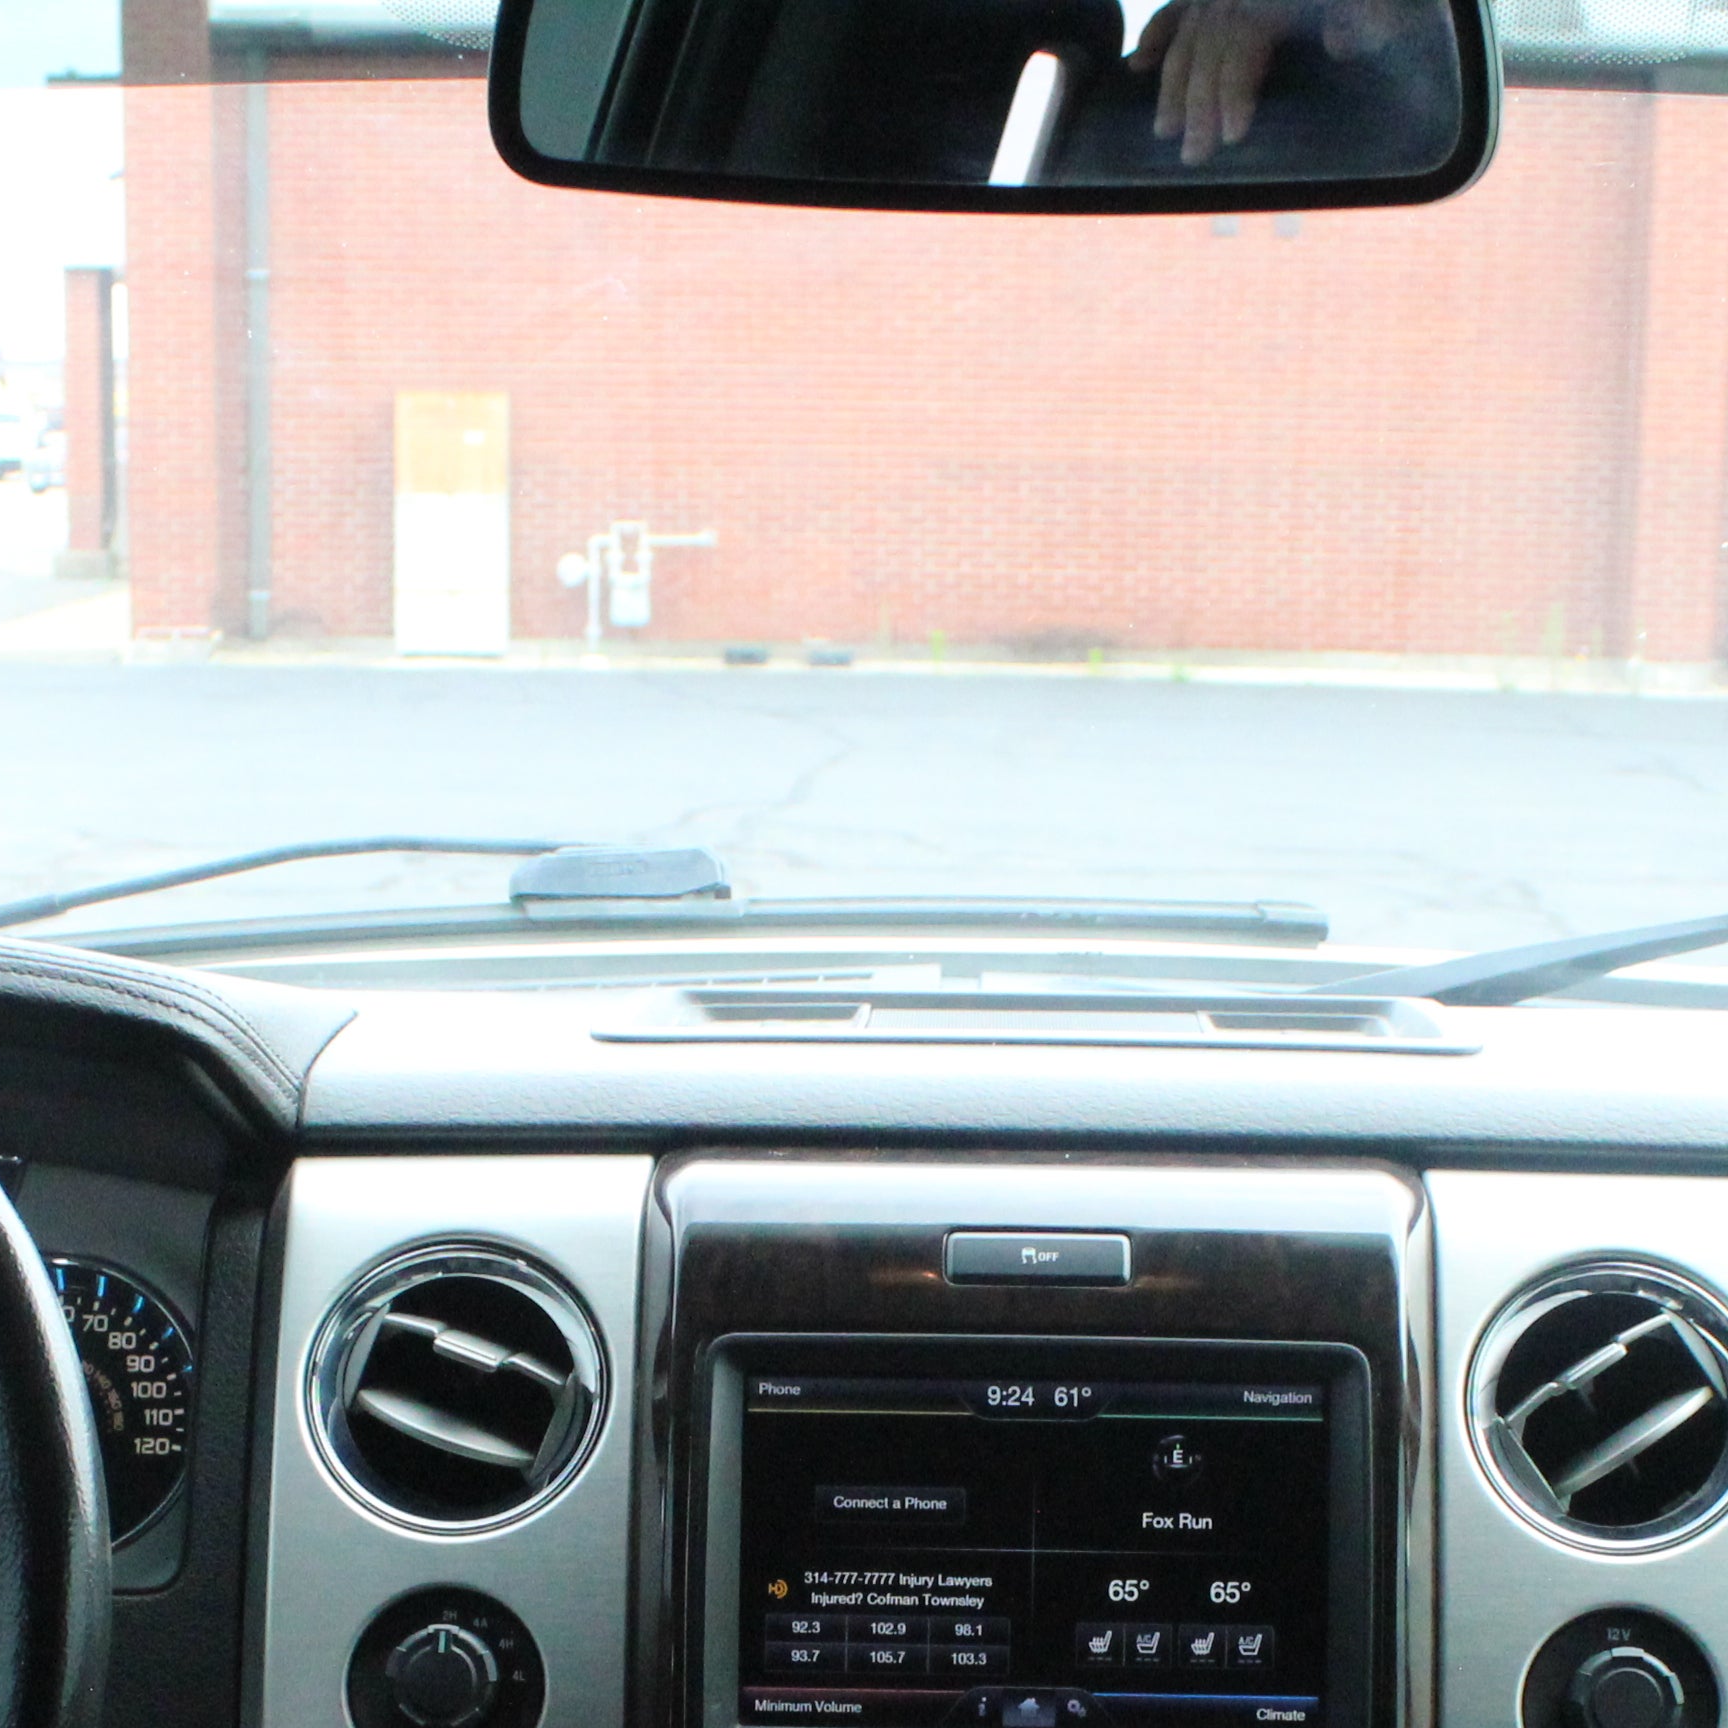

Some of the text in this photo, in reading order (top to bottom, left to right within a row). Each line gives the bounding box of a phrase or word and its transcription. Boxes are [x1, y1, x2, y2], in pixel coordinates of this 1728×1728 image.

[1038, 1251, 1060, 1262] OFF
[82, 1313, 109, 1333] 70
[108, 1331, 137, 1350] 80
[126, 1354, 156, 1373] 90
[130, 1381, 168, 1399] 100
[758, 1382, 801, 1395] Phone
[987, 1385, 1092, 1408] 9:24 61°
[1243, 1388, 1313, 1406] Navigation
[143, 1408, 174, 1427] 110
[133, 1437, 170, 1455] 120
[1172, 1449, 1184, 1463] E
[833, 1496, 947, 1511] Connect a Phone
[1142, 1512, 1213, 1531] Fox Run
[804, 1571, 993, 1590] 314-777-7777 Injury Lawyers
[1108, 1579, 1150, 1603] 65°
[1209, 1581, 1251, 1604] 65°
[811, 1592, 985, 1610] Injured? Cofman Townsley
[441, 1610, 457, 1621] 2H
[791, 1620, 821, 1635] 92.3
[870, 1622, 907, 1636] 102.9
[954, 1623, 983, 1637] 98.1
[1607, 1627, 1631, 1641] 12V
[498, 1638, 514, 1649] 4H
[791, 1649, 820, 1663] 93.7
[870, 1651, 906, 1664] 105.7
[951, 1652, 987, 1666] 103.3
[512, 1670, 526, 1681] 4L
[754, 1699, 863, 1713] Minimum Volume
[1256, 1707, 1306, 1721] Climate
